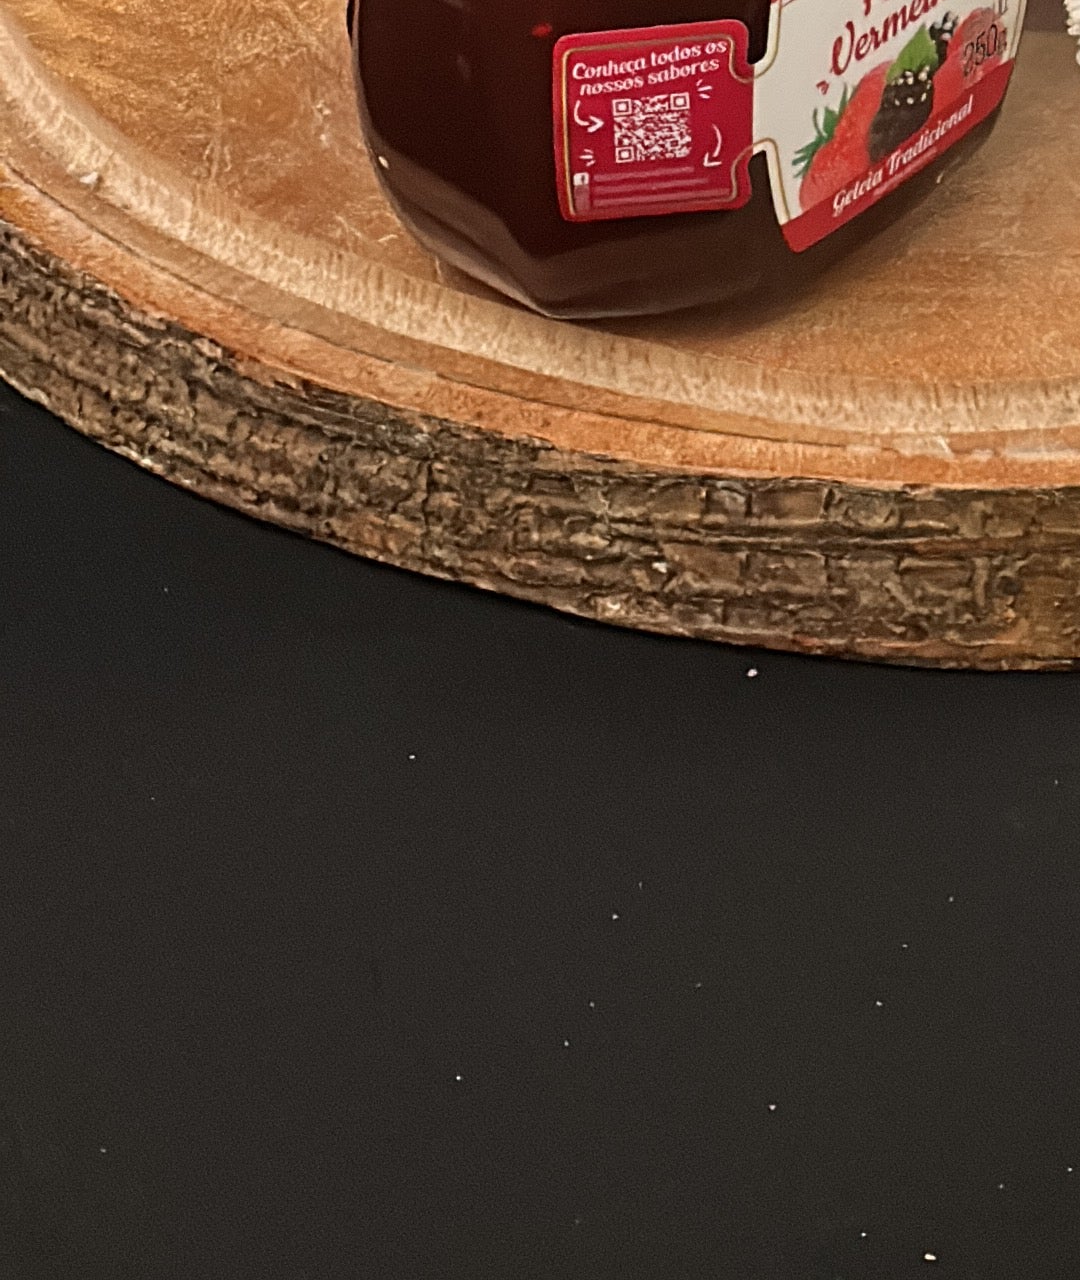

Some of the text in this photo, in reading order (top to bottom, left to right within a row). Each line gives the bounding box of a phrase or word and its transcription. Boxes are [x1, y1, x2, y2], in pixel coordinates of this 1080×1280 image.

[572, 41, 728, 80] Conheça todos os
[579, 58, 720, 96] nossos sabores
[832, 168, 883, 217] Geleia
[886, 94, 974, 175] Tradicional
